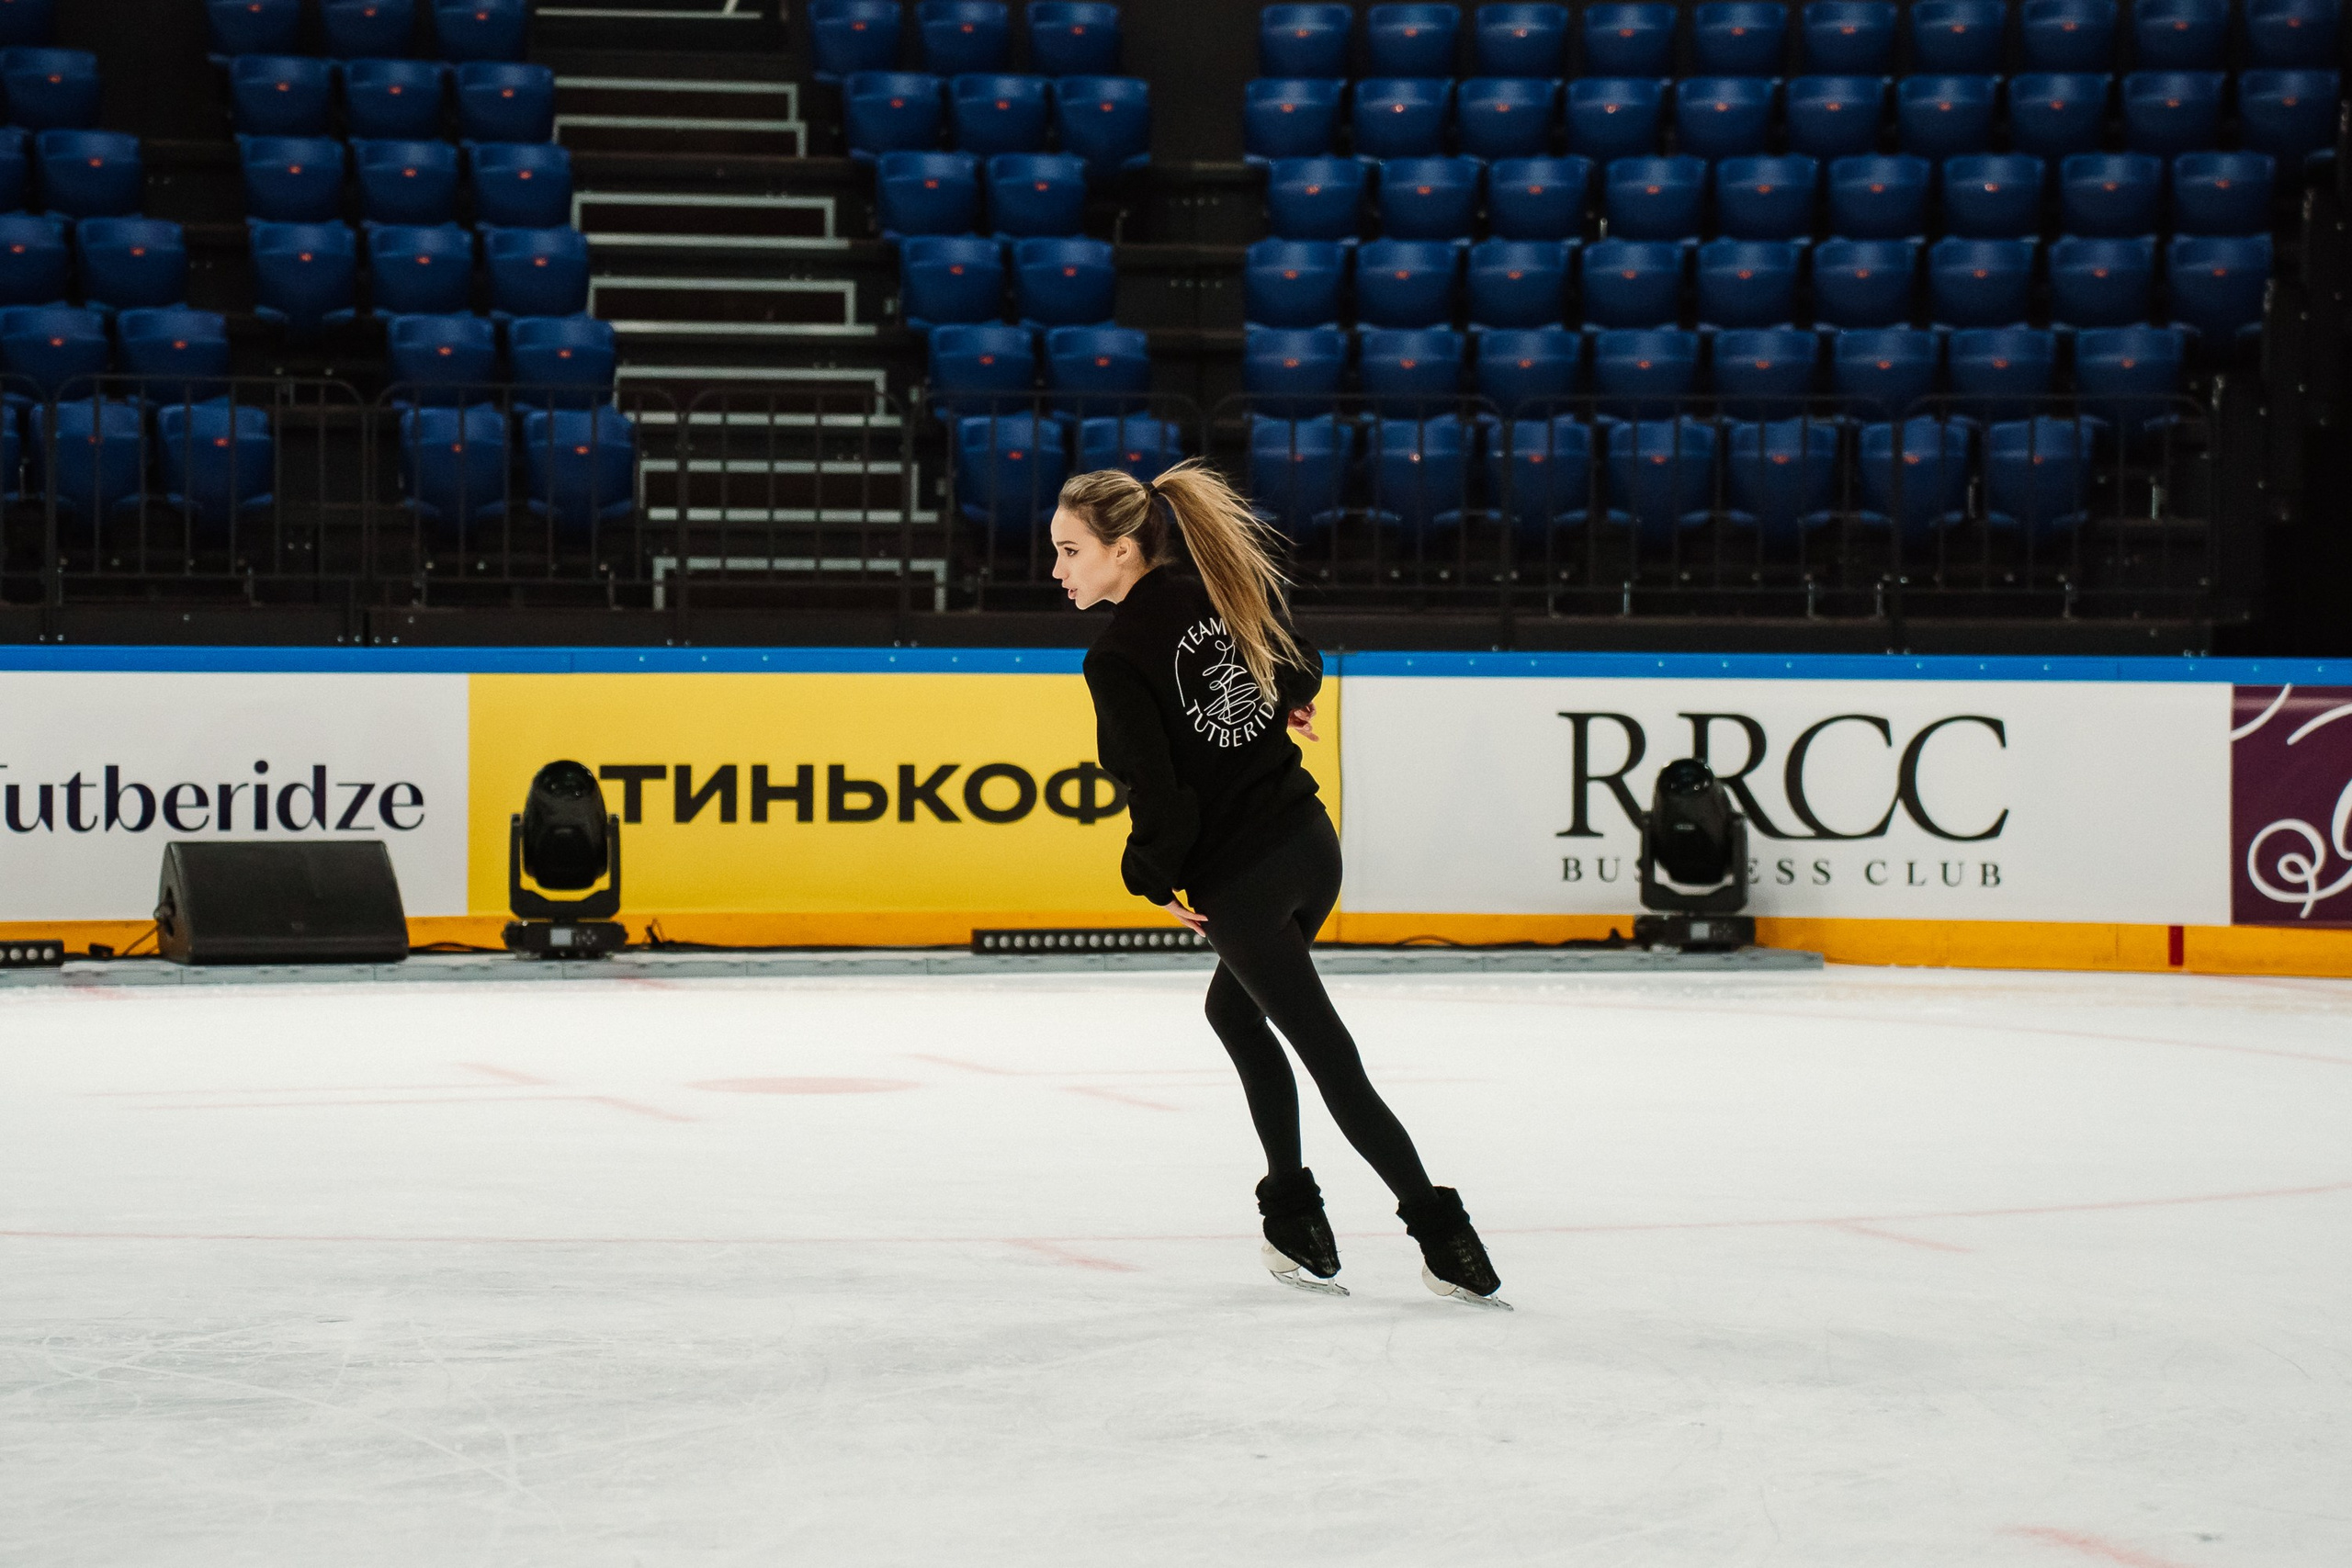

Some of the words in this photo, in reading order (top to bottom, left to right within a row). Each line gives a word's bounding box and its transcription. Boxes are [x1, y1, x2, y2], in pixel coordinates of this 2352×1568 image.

[1178, 617, 1227, 654] TEAM
[1186, 670, 1278, 748] TUTBERID
[0, 760, 425, 833] utberidze
[599, 761, 1129, 825] ТИНЬКОФ
[1555, 711, 2009, 842] RRCC
[1561, 857, 1831, 886] BUESS
[1864, 861, 2003, 887] CLUB
